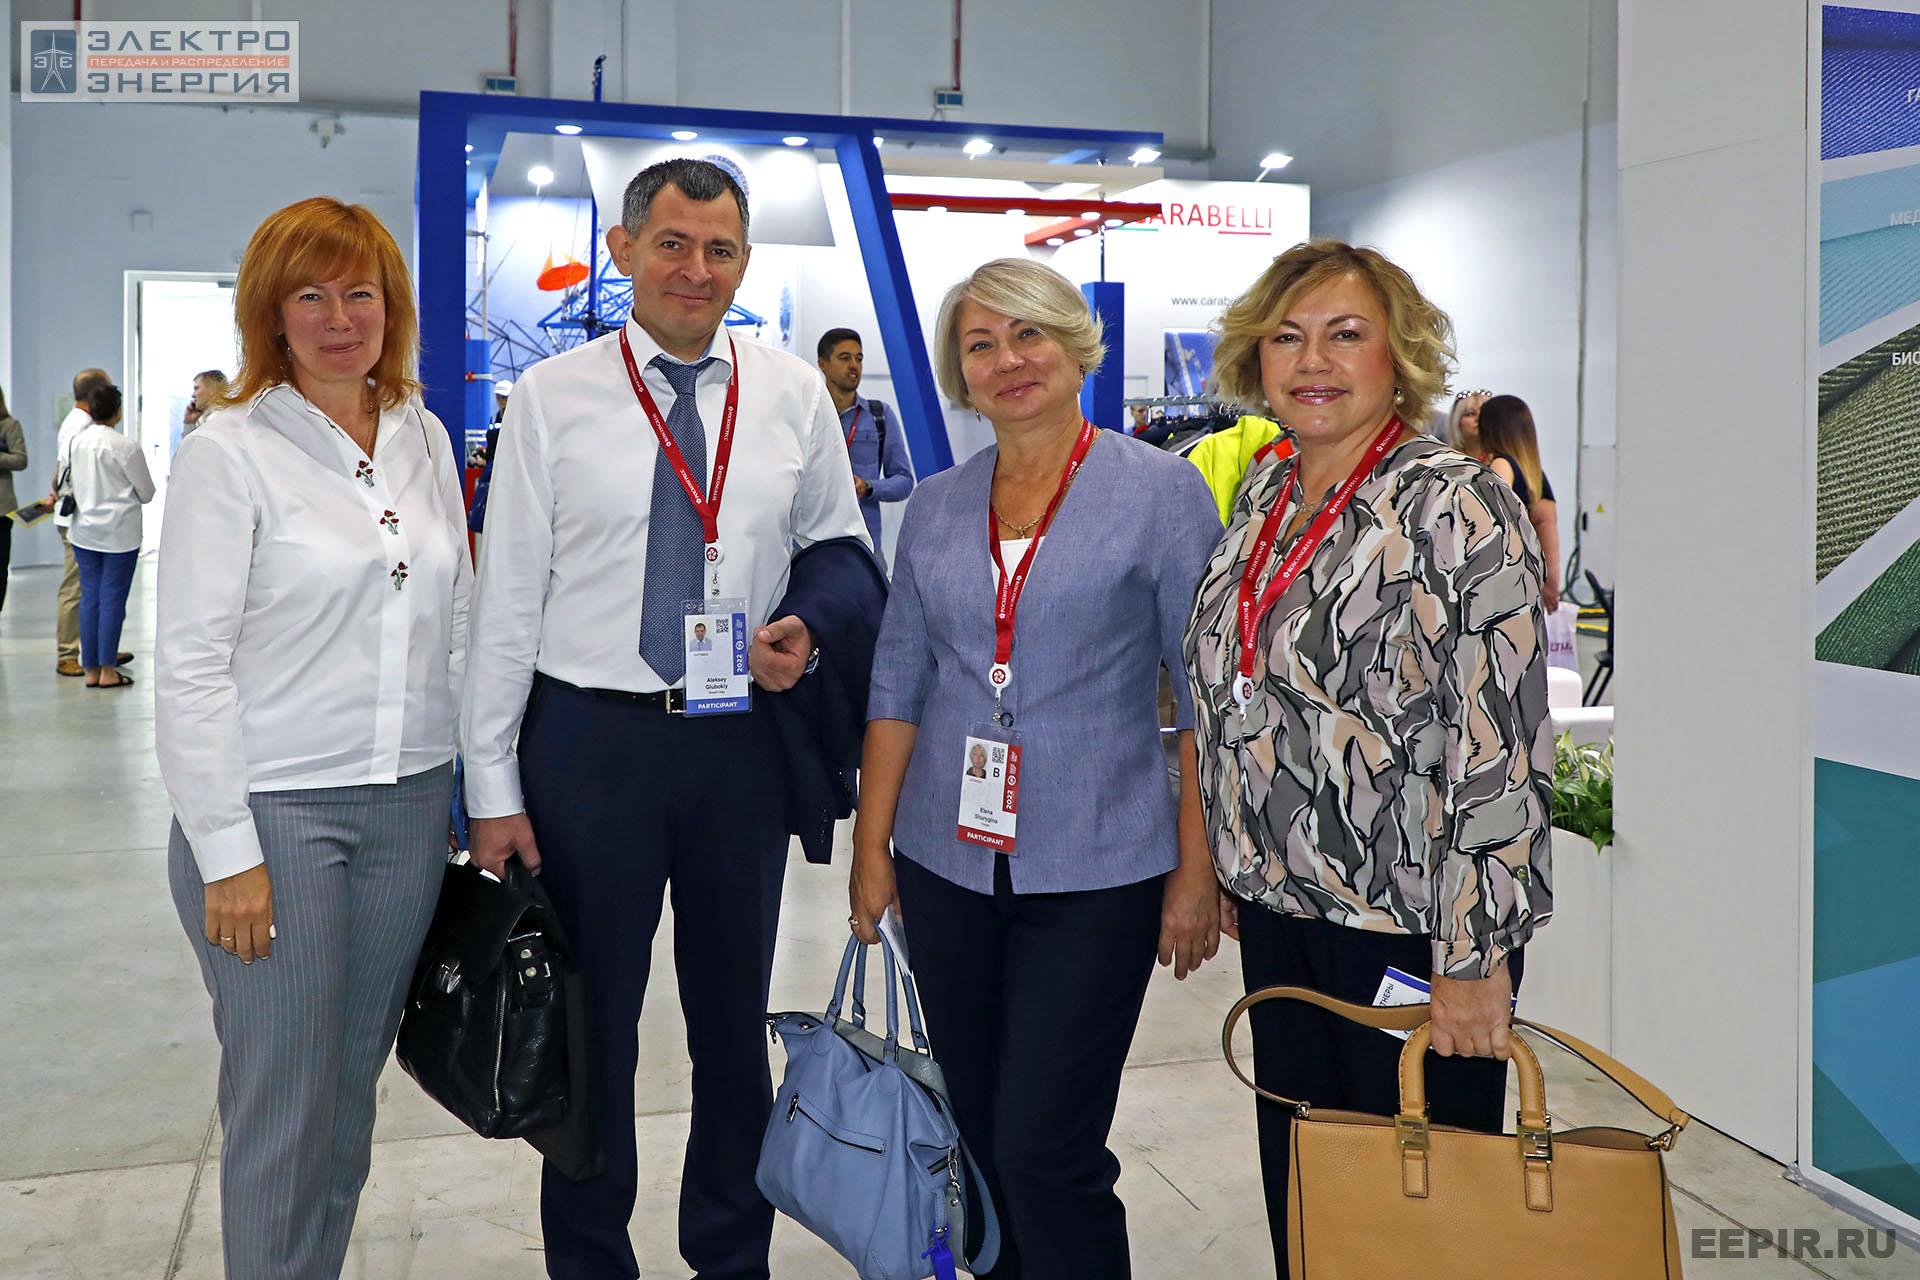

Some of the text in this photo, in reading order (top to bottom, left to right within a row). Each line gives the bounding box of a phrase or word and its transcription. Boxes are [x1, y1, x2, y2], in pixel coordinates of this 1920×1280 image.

[1135, 203, 1272, 229] ARABELLI
[1286, 538, 1315, 574] ROSCONGRESS
[697, 701, 738, 710] PARTICIPANT
[966, 831, 1004, 846] PARTICIPANT
